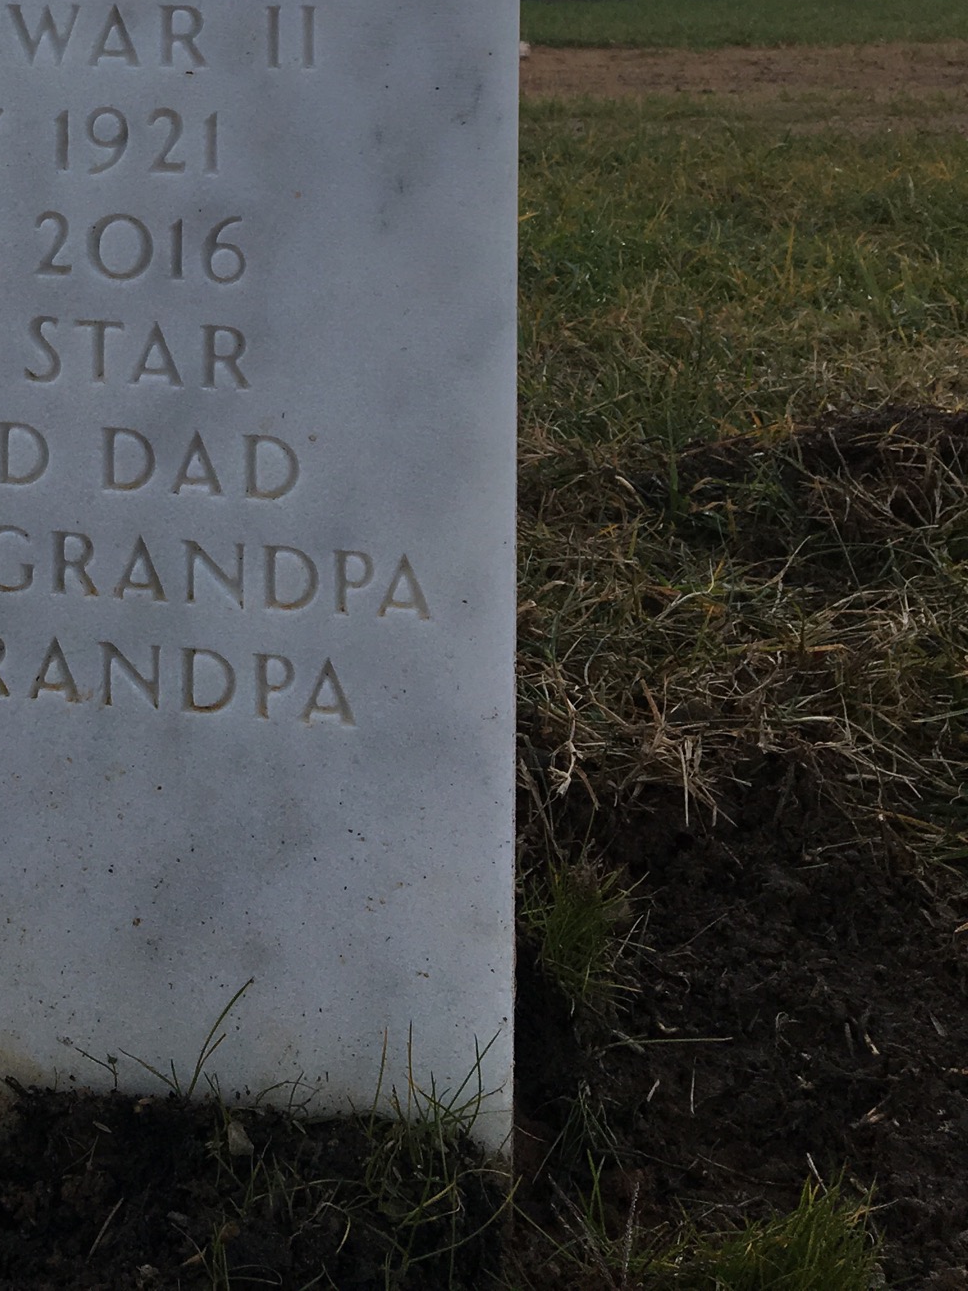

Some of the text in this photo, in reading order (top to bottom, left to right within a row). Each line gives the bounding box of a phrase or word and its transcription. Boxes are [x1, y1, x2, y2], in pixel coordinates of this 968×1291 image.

[5, 3, 206, 68] WAR
[265, 3, 316, 70] II
[52, 107, 219, 176] 1921
[33, 210, 247, 284] 2016
[23, 314, 252, 390] STAR
[100, 425, 301, 501] DAD
